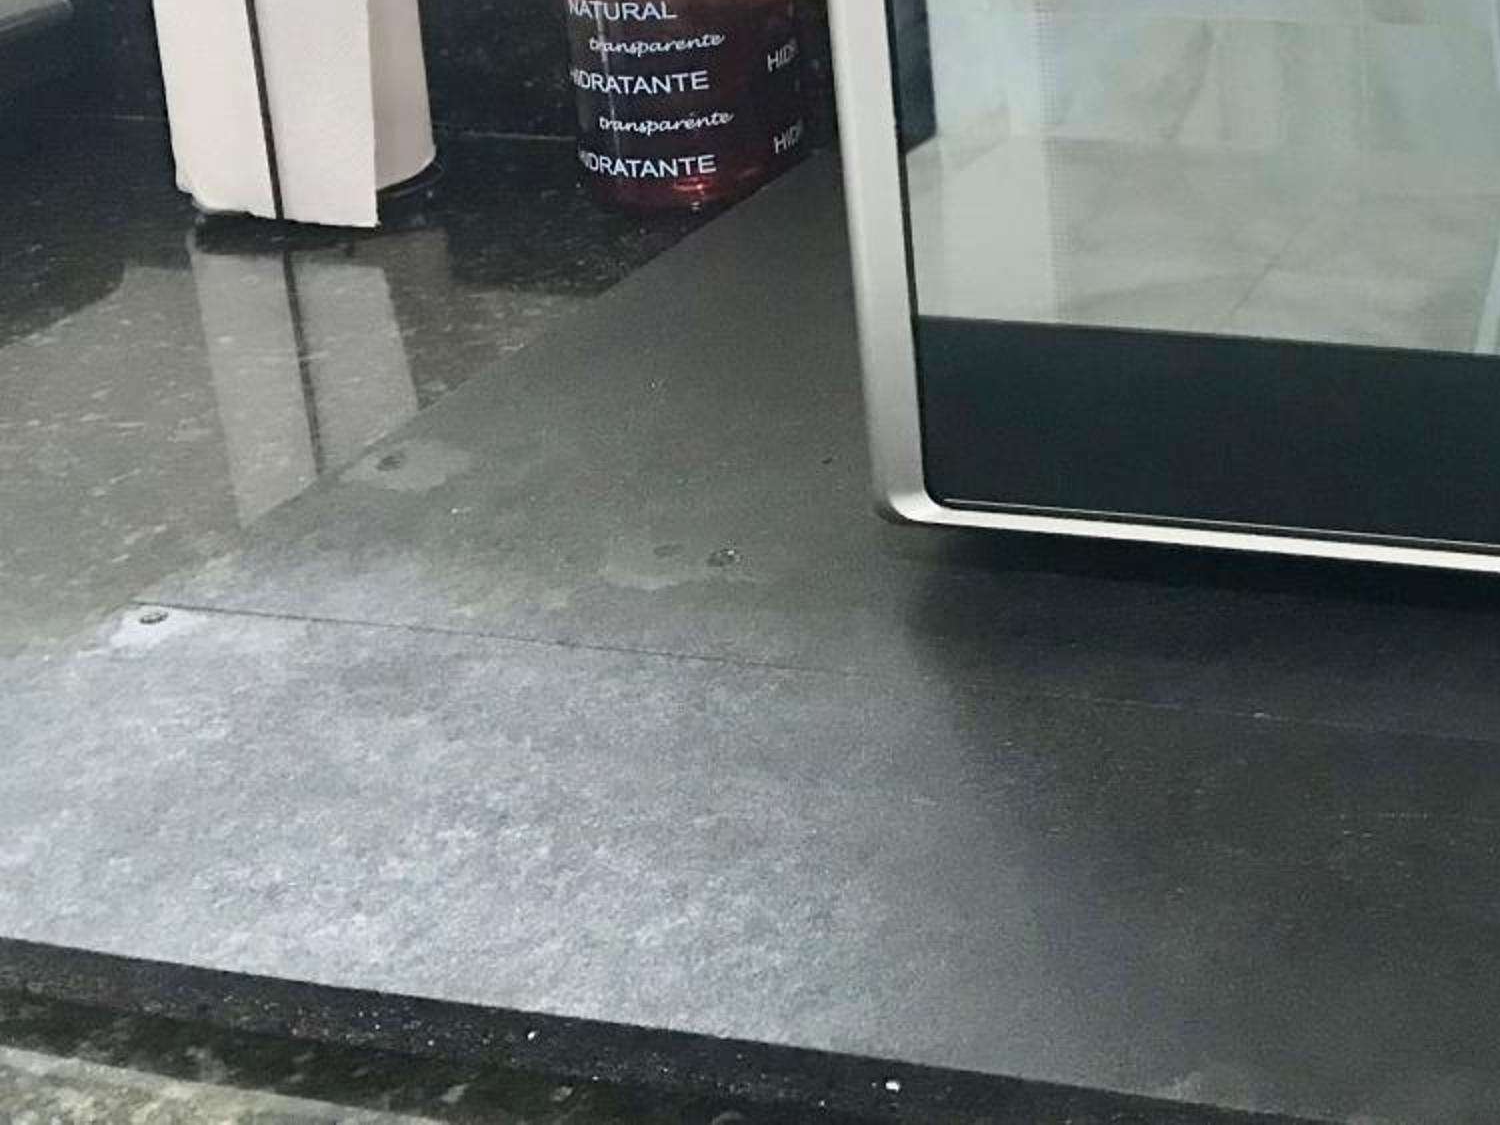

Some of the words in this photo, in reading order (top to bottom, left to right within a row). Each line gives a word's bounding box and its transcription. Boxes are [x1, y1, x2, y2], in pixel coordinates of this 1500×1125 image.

[589, 33, 725, 57] transparente
[767, 38, 798, 72] HID
[599, 112, 735, 136] transparente
[773, 120, 803, 154] HID
